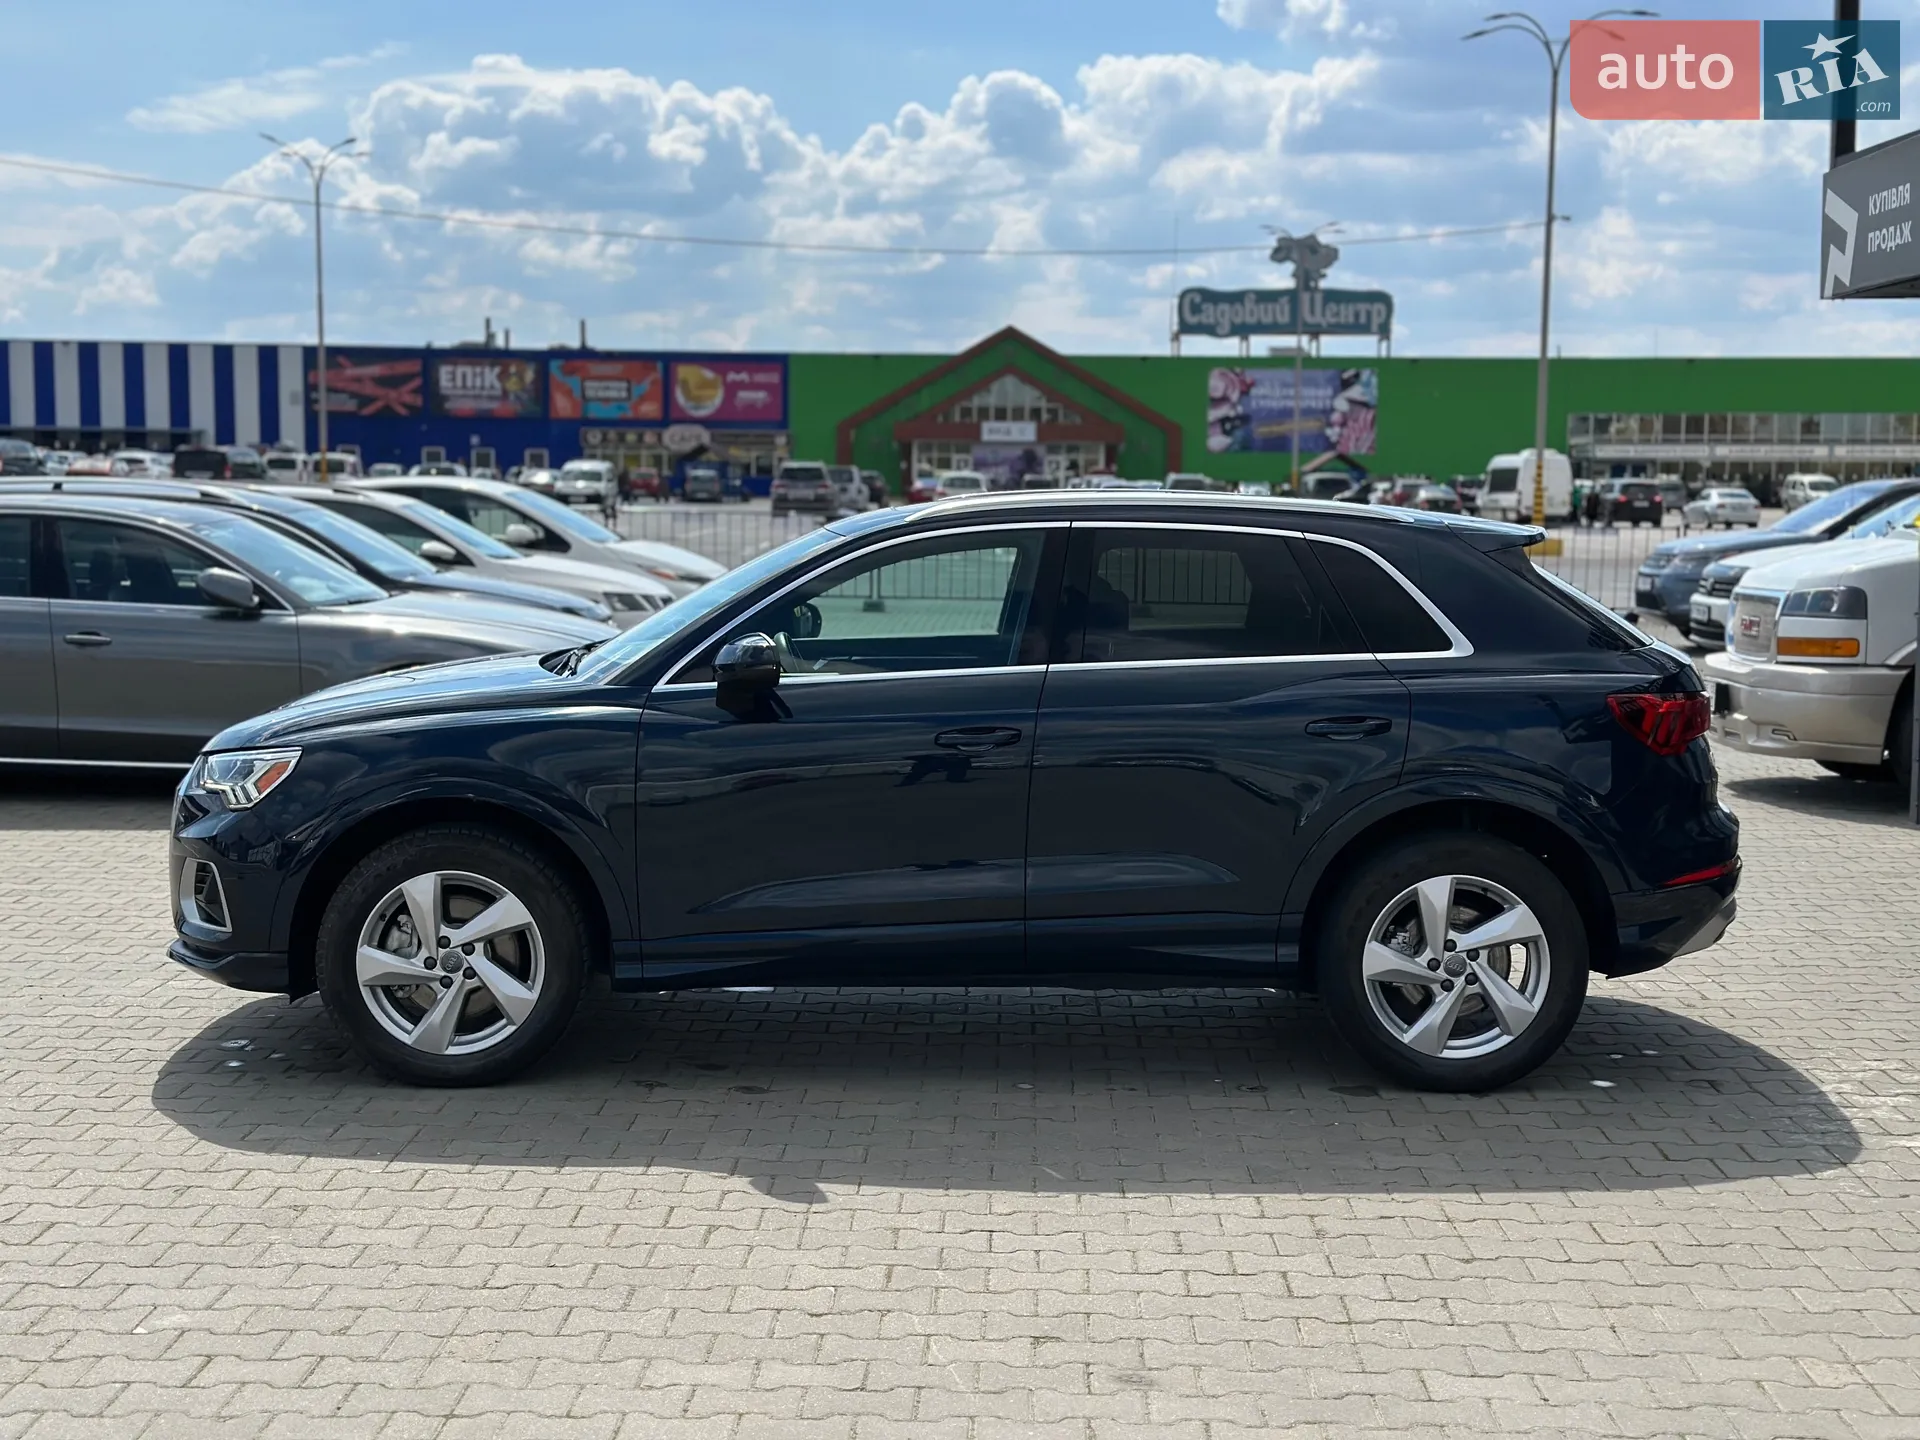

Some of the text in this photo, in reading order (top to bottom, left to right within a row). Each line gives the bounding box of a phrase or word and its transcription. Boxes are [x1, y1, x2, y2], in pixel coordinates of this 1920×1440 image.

[1869, 182, 1910, 216] КУПІВЛЯ
[1868, 220, 1912, 253] ПРОДАЖ
[1182, 291, 1387, 335] Садовий Центр
